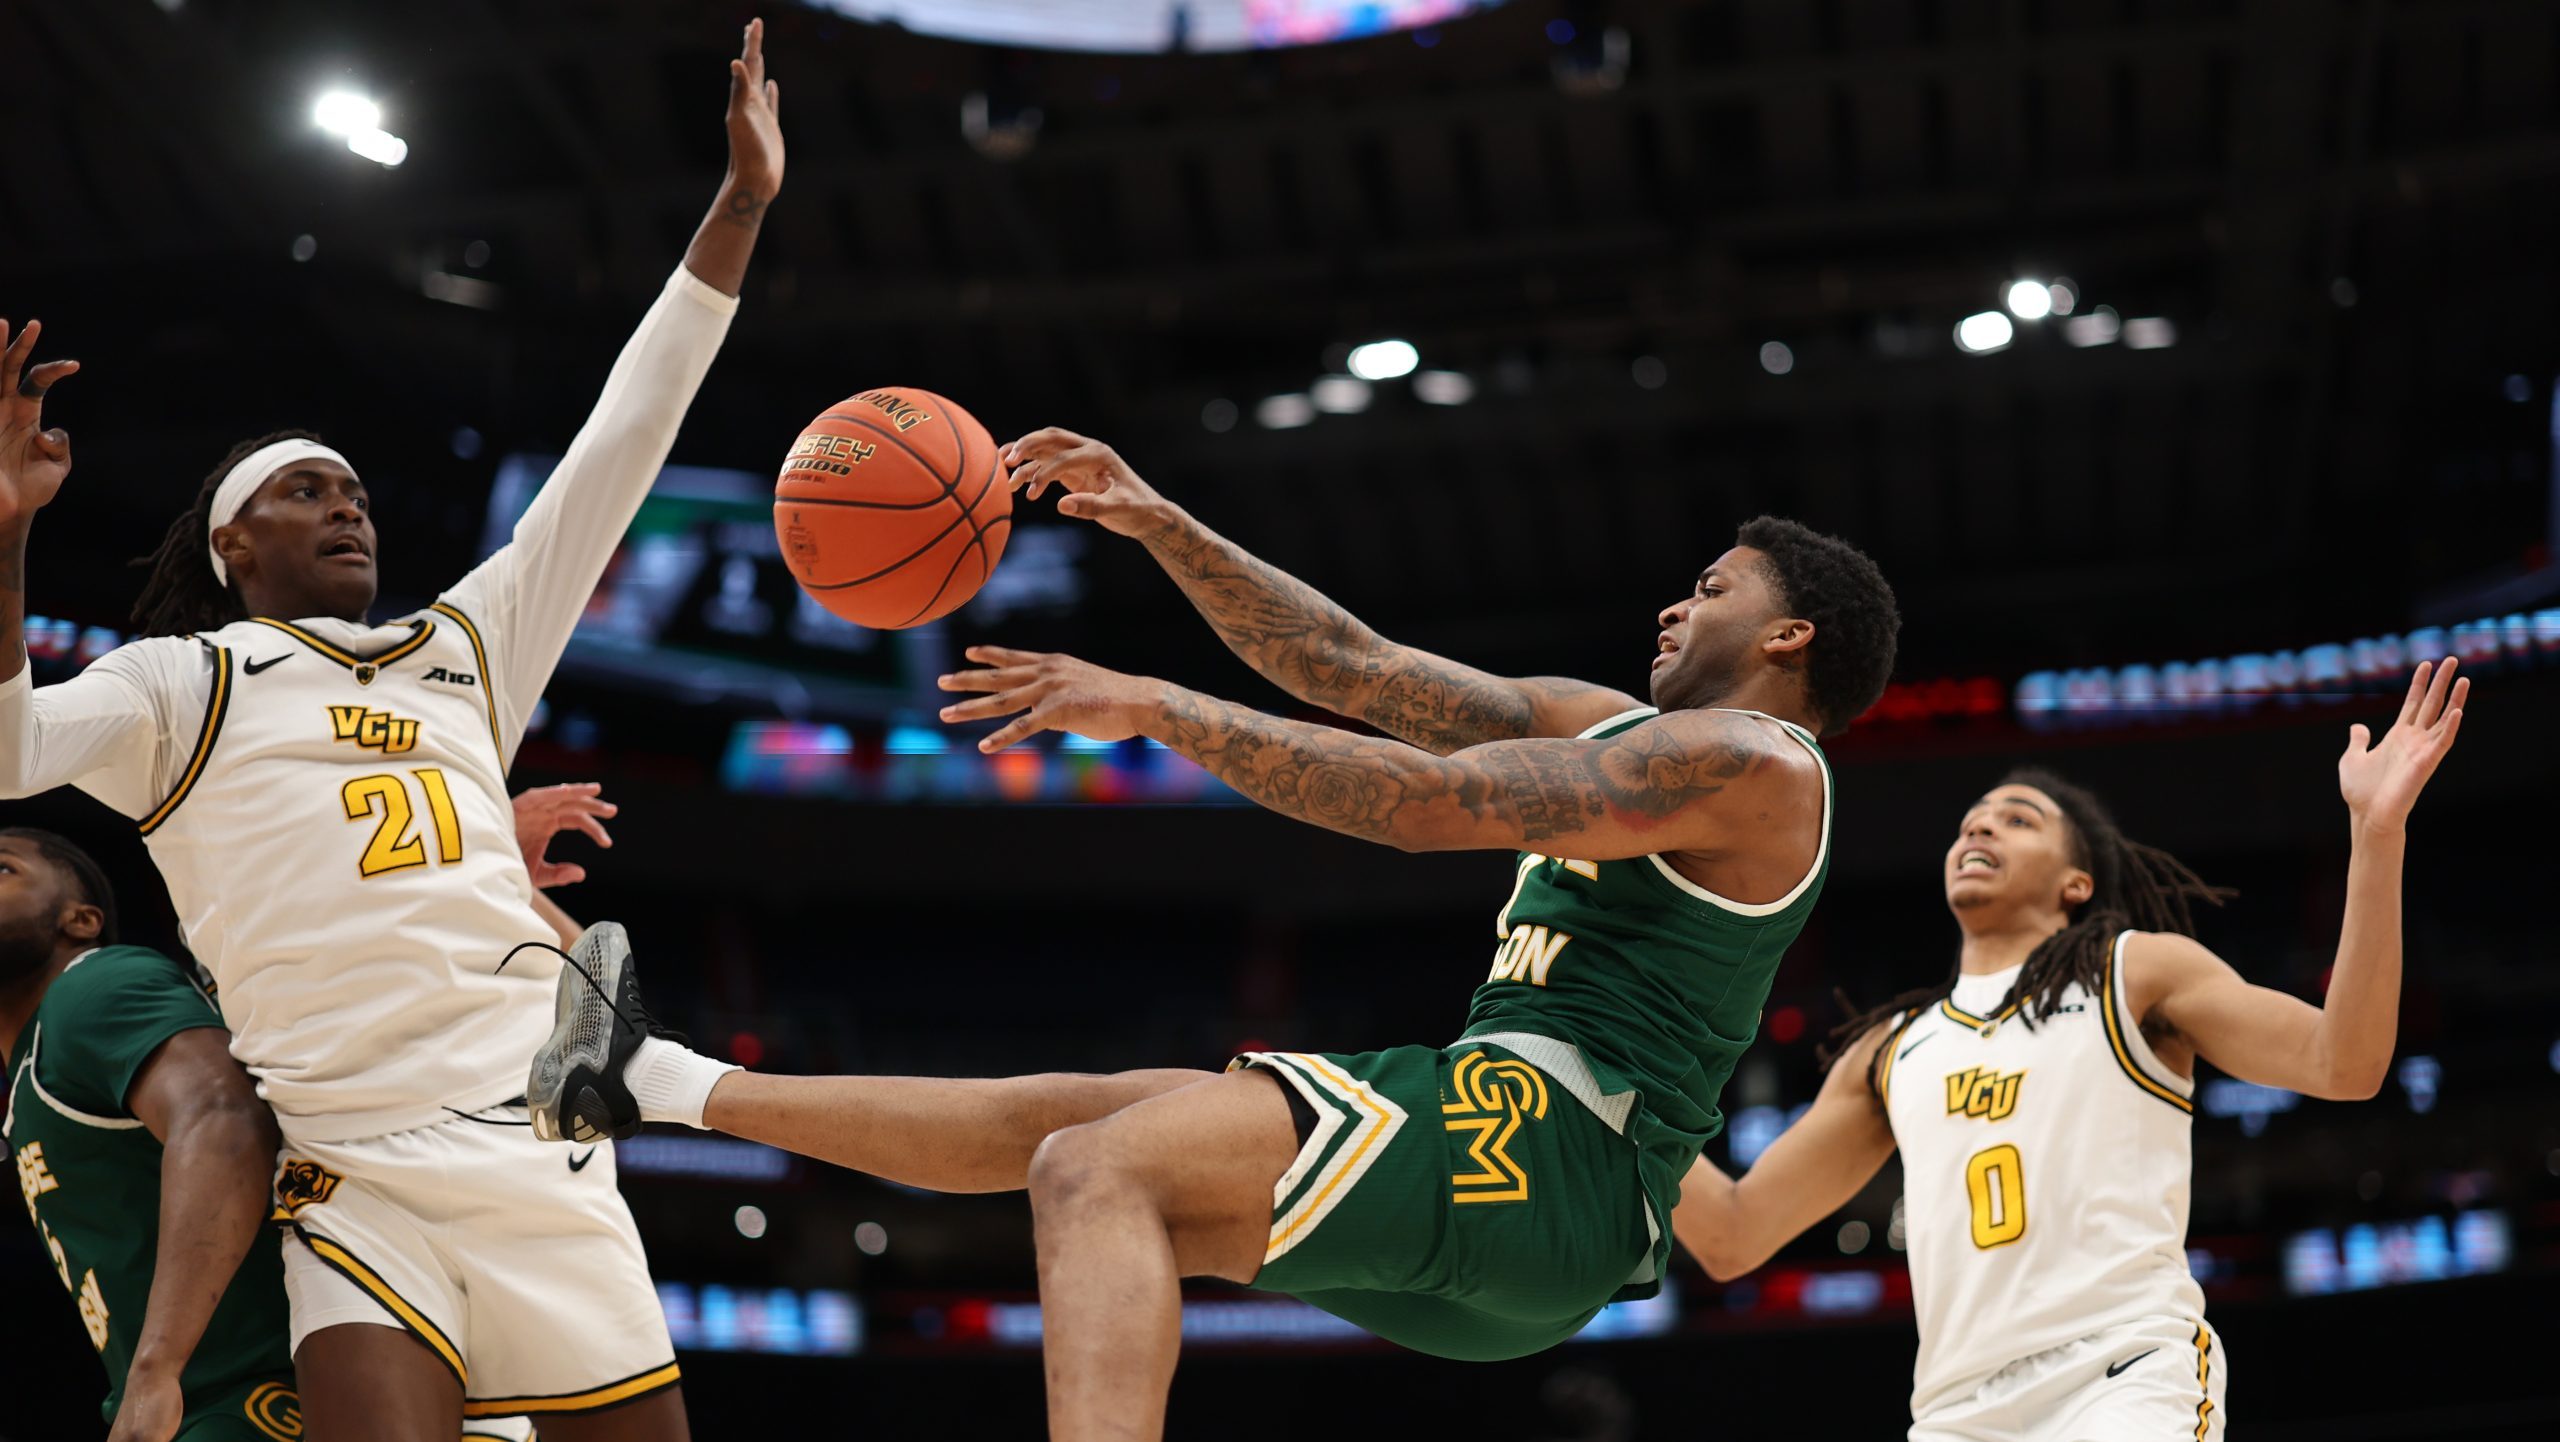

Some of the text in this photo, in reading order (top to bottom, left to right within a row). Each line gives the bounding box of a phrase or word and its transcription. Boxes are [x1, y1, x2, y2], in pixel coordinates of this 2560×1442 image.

[325, 705, 421, 754] VCU
[341, 767, 464, 880] 21
[1487, 924, 1574, 987] ON
[1943, 1066, 2028, 1122] VCU
[1966, 1143, 2026, 1250] 0
